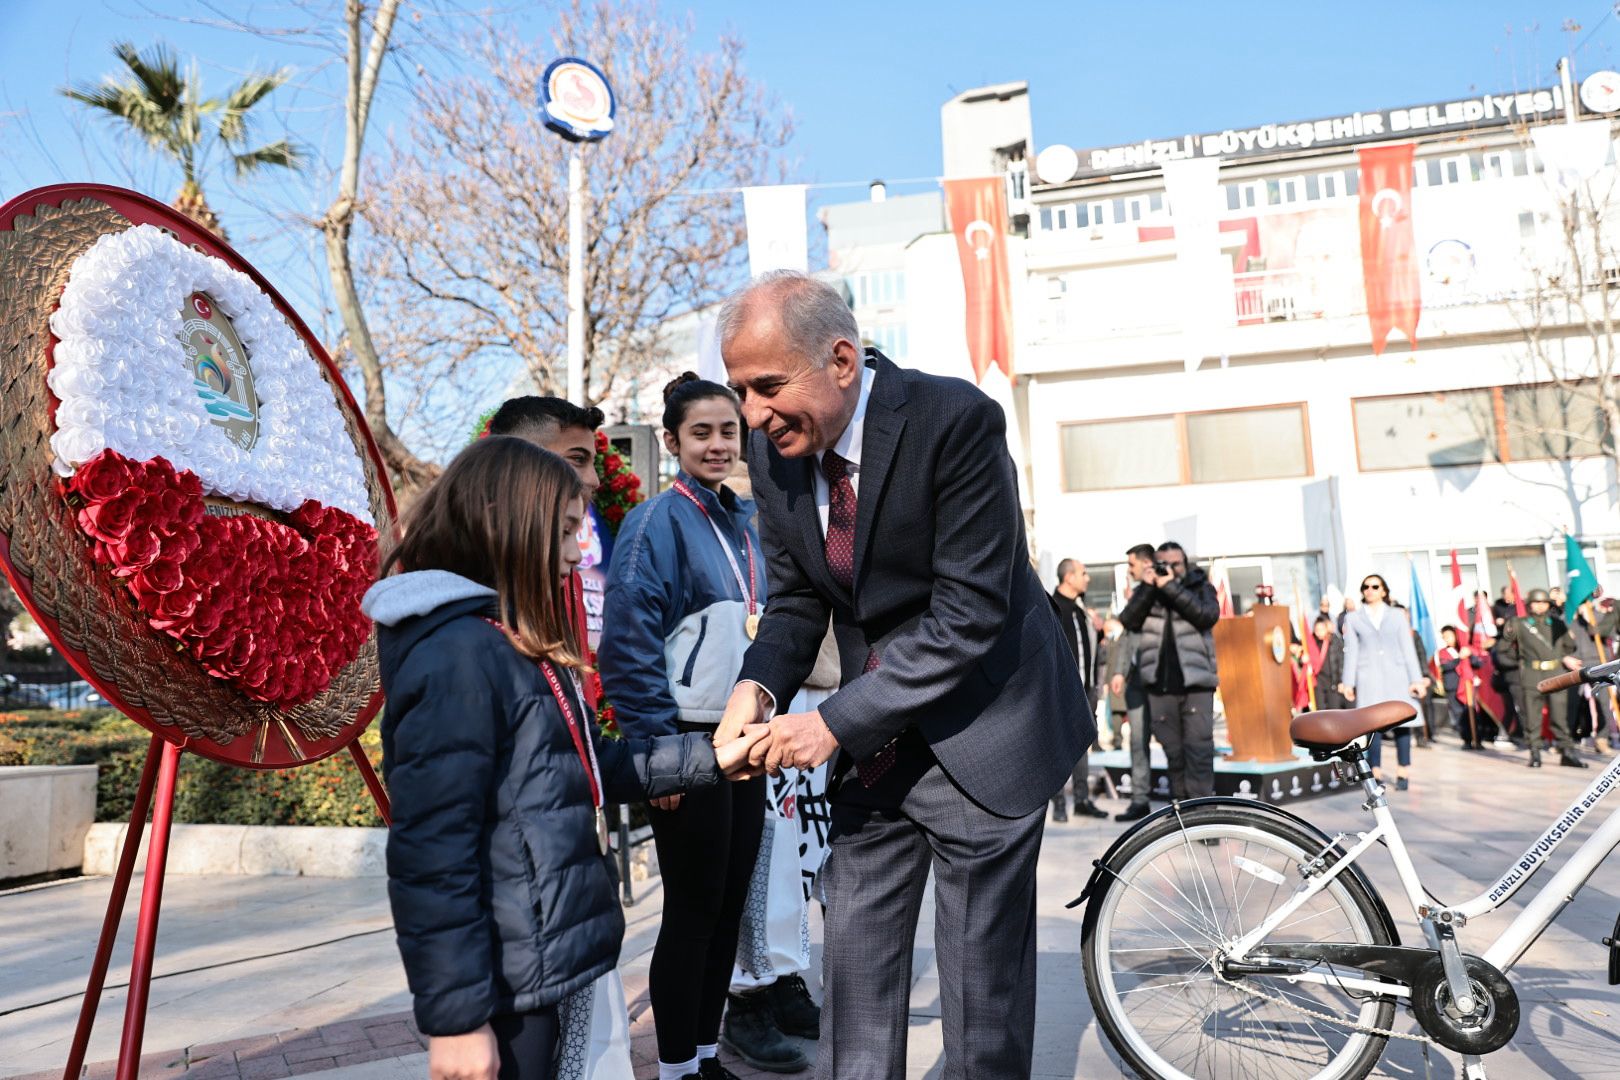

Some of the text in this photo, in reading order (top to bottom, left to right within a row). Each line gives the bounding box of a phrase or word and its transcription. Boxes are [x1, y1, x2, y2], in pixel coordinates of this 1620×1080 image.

[1091, 85, 1565, 171] DENİZLİ BÜYÜKŞEHİR BELEDİYESİ
[1488, 762, 1620, 903] DENİZLİ BÜYÜKŞEHİR BELEDİYE
